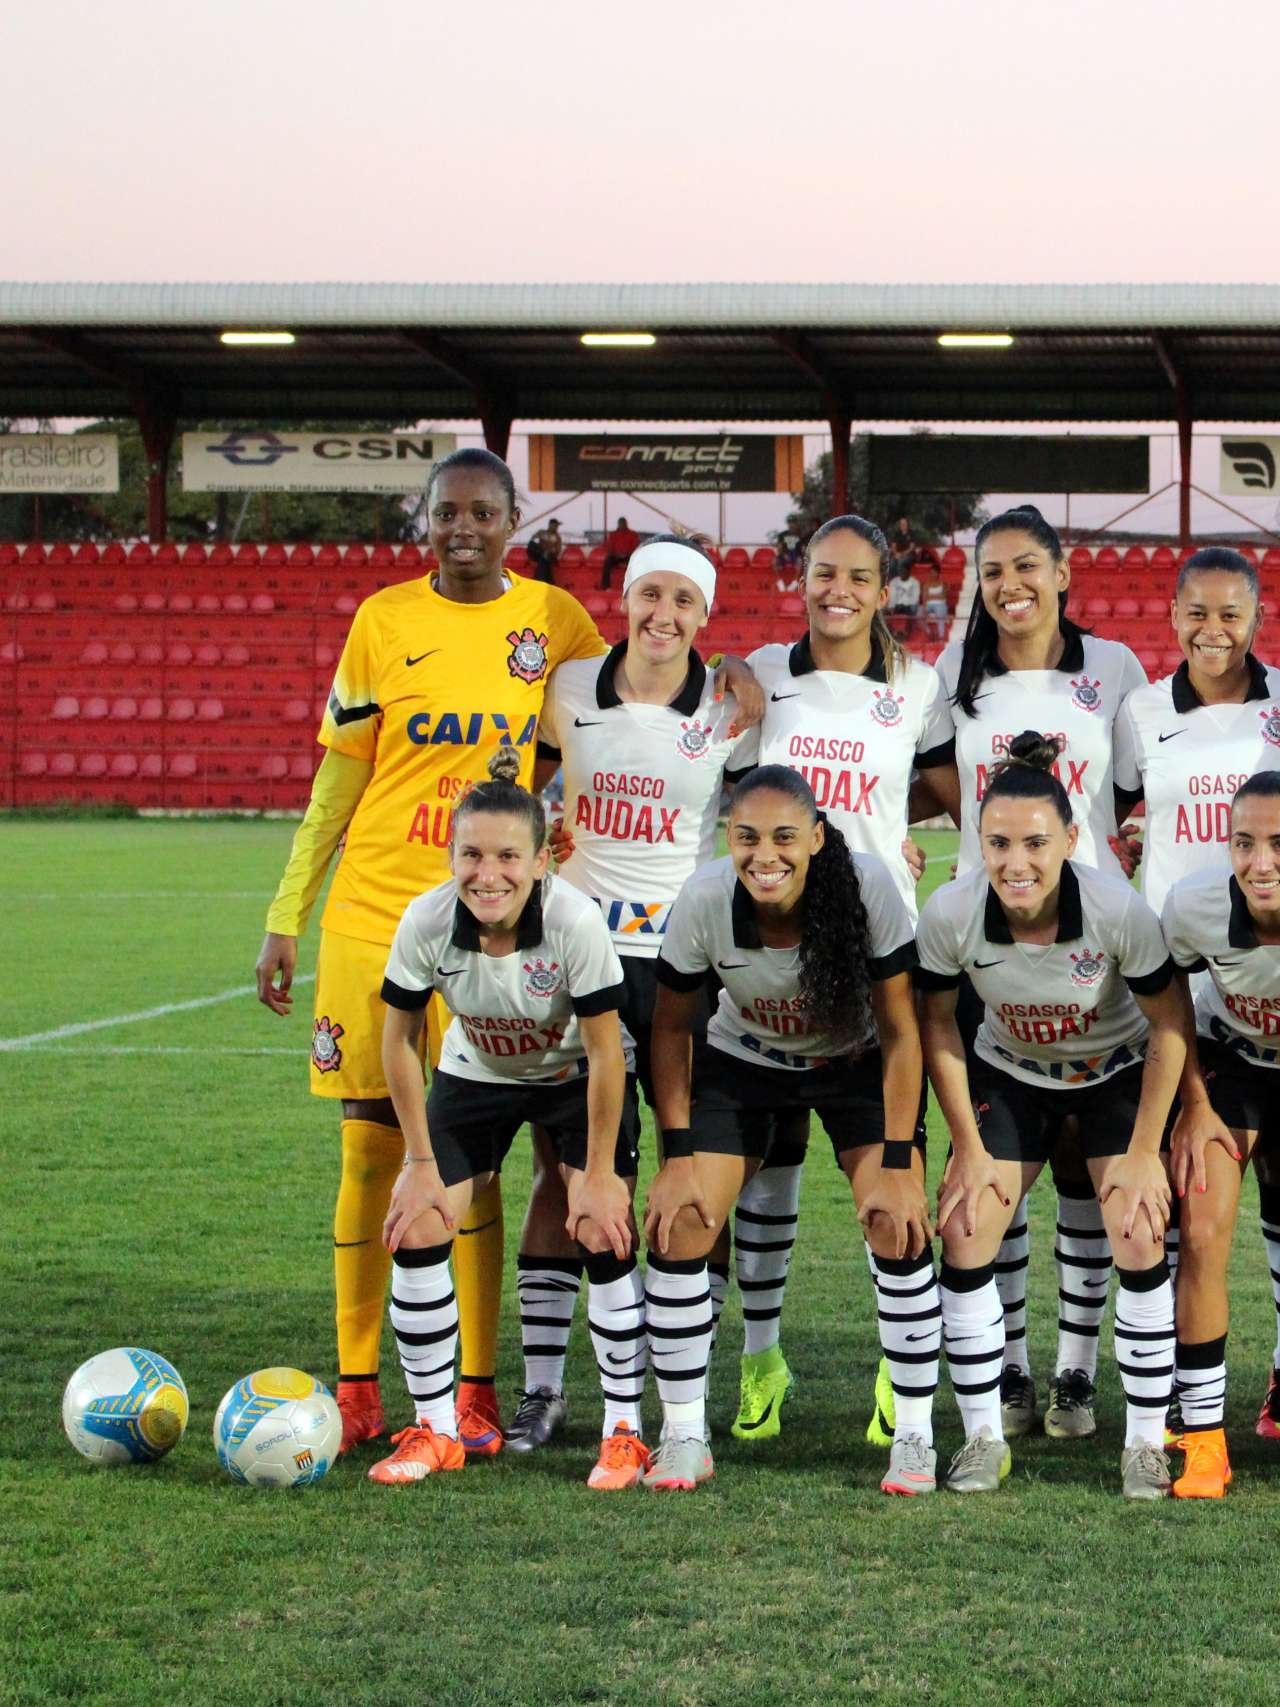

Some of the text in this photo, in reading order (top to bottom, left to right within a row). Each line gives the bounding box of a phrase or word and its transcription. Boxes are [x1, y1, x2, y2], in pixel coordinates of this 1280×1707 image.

[0, 437, 105, 468] rasileiro
[313, 439, 434, 460] CSN
[579, 437, 744, 462] connect
[682, 463, 735, 476] parts
[407, 712, 537, 747] CAIXA
[789, 735, 865, 763] OSASCO
[593, 771, 666, 800] OSASCO
[789, 765, 881, 816] DAX
[1189, 774, 1249, 796] OSASC
[576, 794, 682, 845] AUDAX
[1175, 802, 1233, 844] AUD
[753, 998, 804, 1013] OSAS
[1001, 1003, 1081, 1018] OSASCO
[460, 1014, 537, 1032] OSASCO
